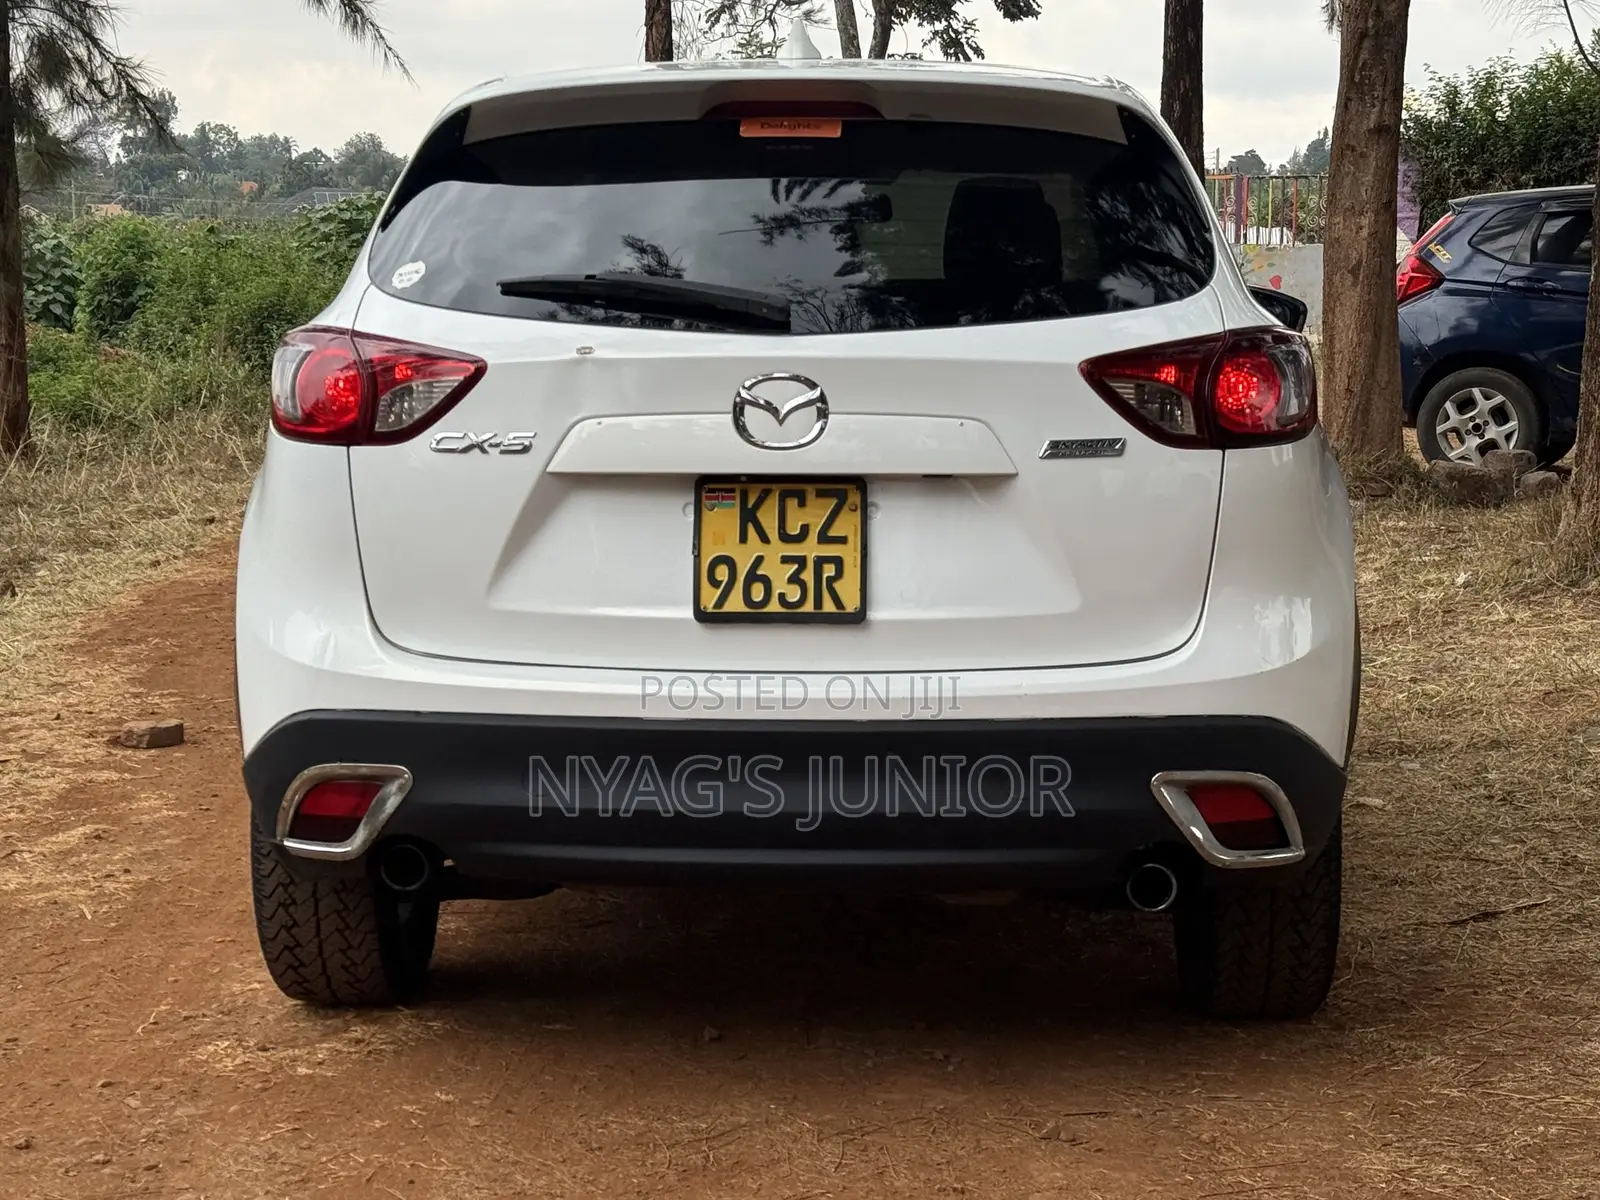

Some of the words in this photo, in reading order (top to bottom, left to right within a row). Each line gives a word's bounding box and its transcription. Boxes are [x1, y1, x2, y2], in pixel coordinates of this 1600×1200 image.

[429, 431, 537, 455] CX-5
[738, 488, 849, 545] KCZ
[706, 553, 846, 611] 963R
